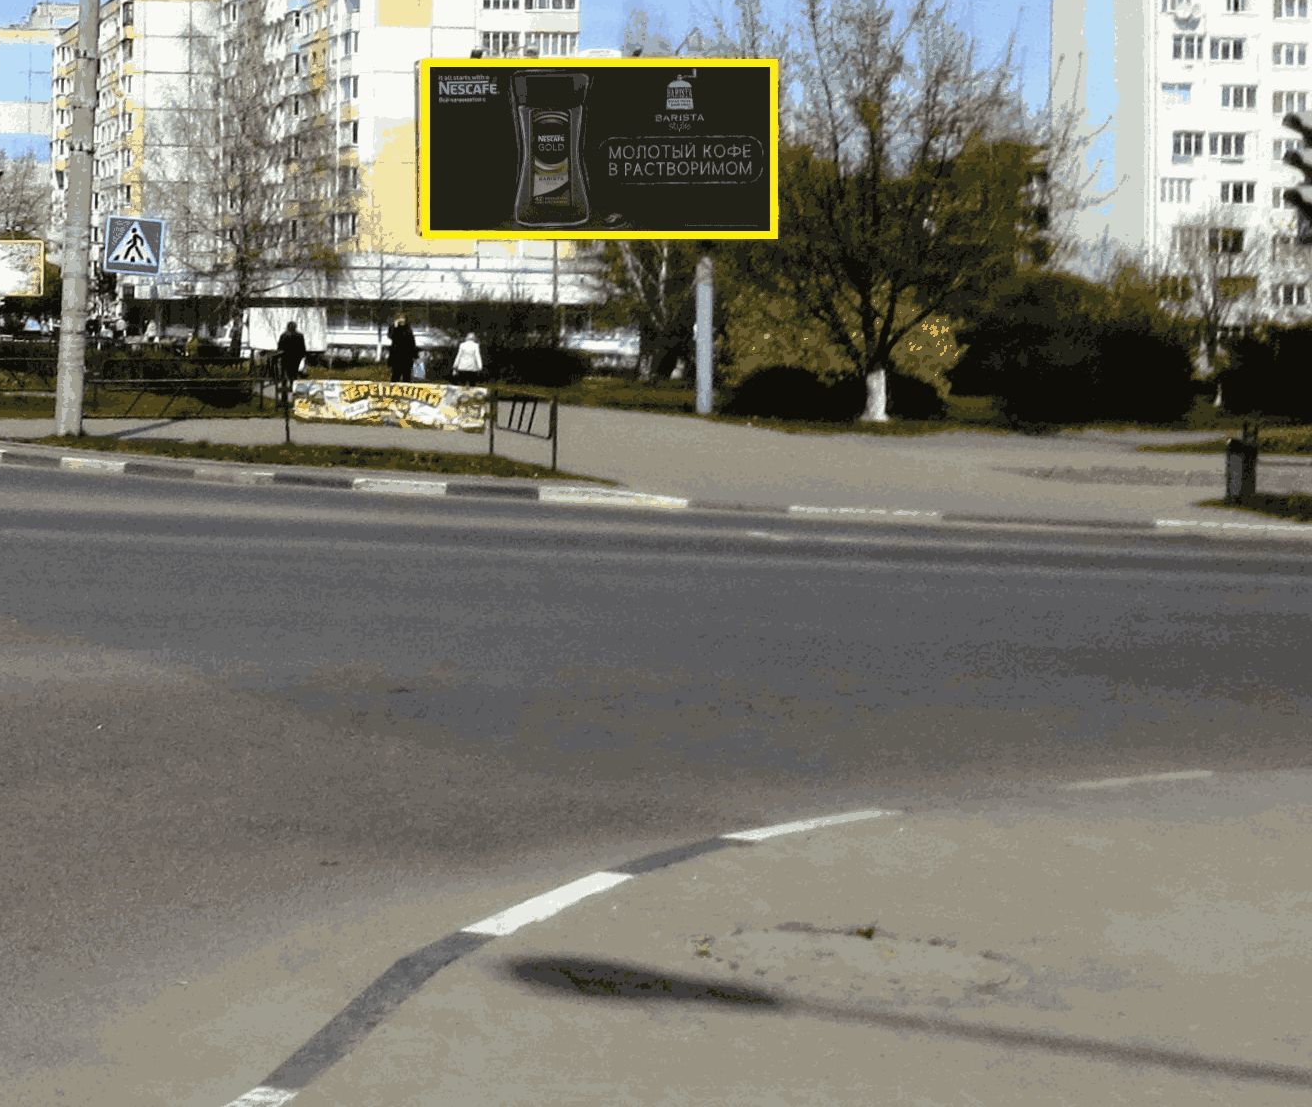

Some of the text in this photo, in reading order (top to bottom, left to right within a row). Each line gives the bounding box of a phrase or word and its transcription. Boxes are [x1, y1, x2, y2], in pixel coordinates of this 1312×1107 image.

[655, 113, 705, 122] BARISTA
[538, 143, 565, 151] GOLD
[608, 142, 752, 159] МОЛОТЫЙ КОФЕ
[608, 161, 752, 176] В РАСТВОРИМОМ
